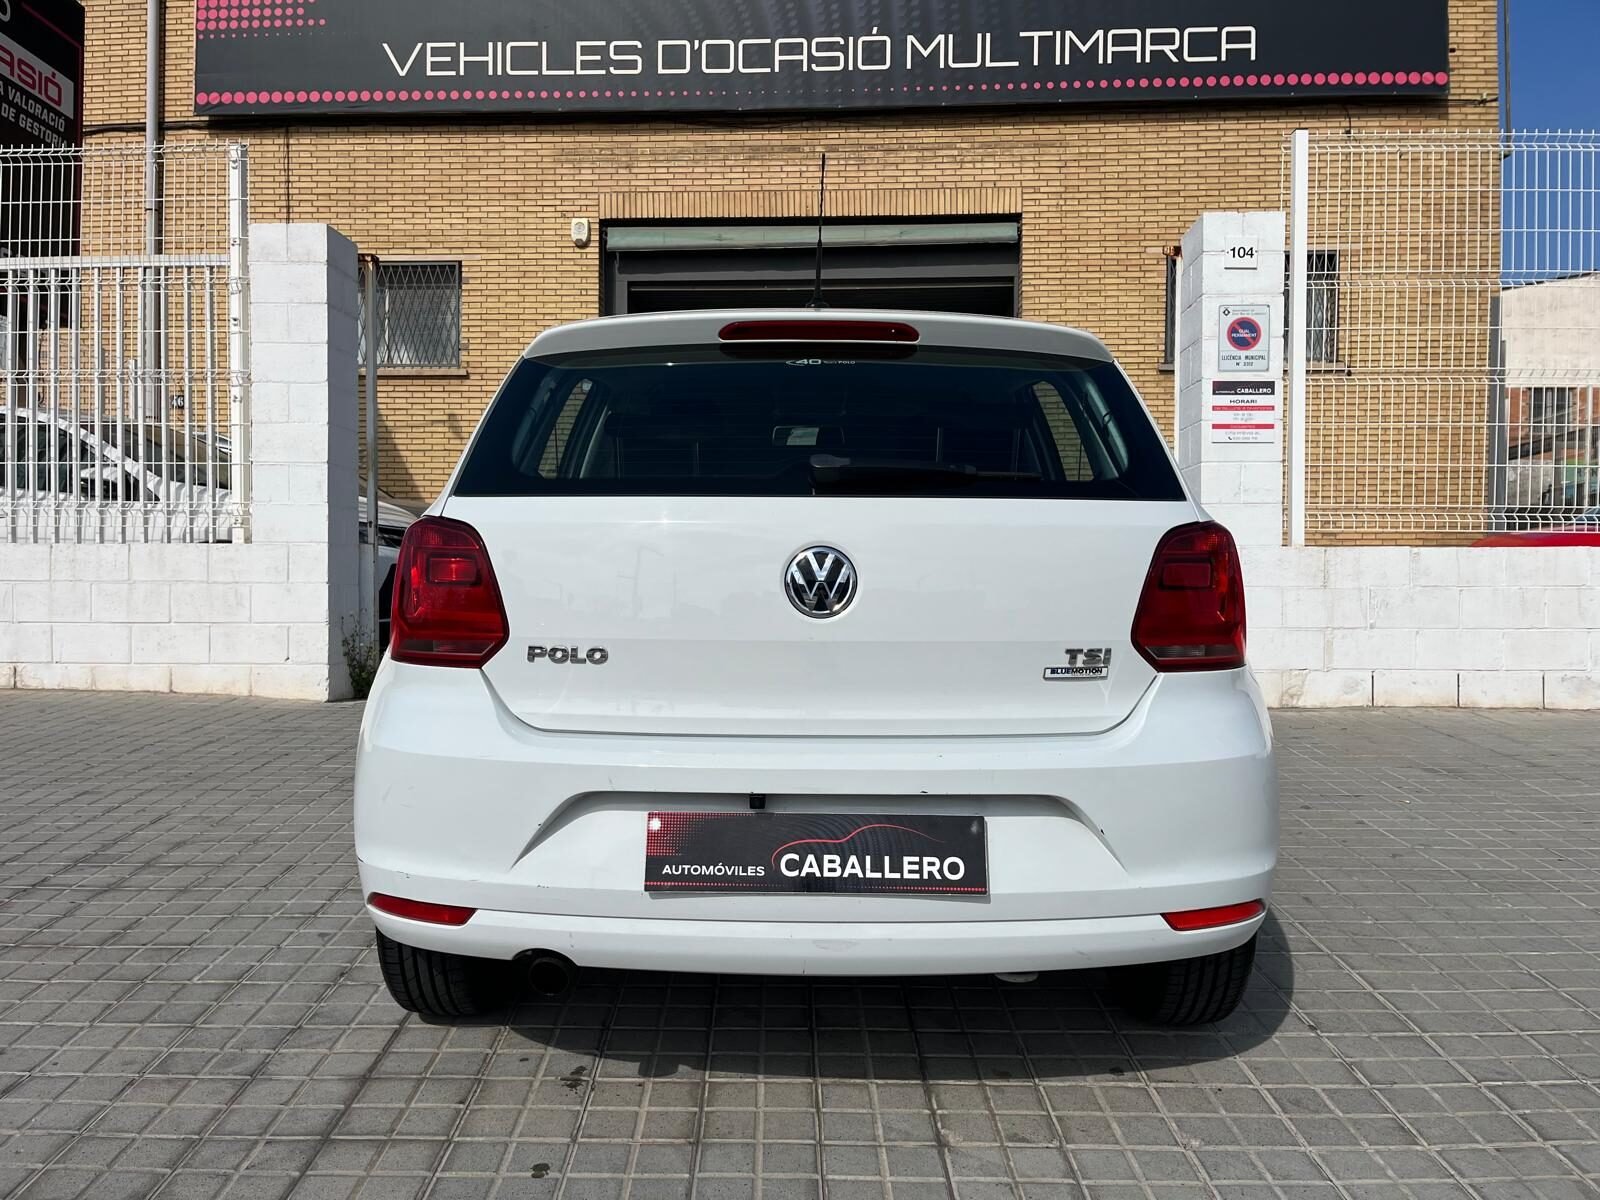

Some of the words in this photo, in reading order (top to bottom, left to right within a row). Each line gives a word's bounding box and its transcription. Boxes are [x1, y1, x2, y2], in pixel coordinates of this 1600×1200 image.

[382, 40, 643, 77] VEHICLES
[906, 26, 1256, 69] MULTIMARCA
[1, 103, 16, 122] DE
[8, 85, 65, 132] VALORACIÓ
[1229, 246, 1255, 259] 104
[526, 645, 609, 665] POLO
[1064, 647, 1112, 667] TSI
[1050, 667, 1103, 675] BLUEMOTION
[661, 863, 765, 877] AUTOMÓVILES
[779, 853, 966, 881] CABALLERO
